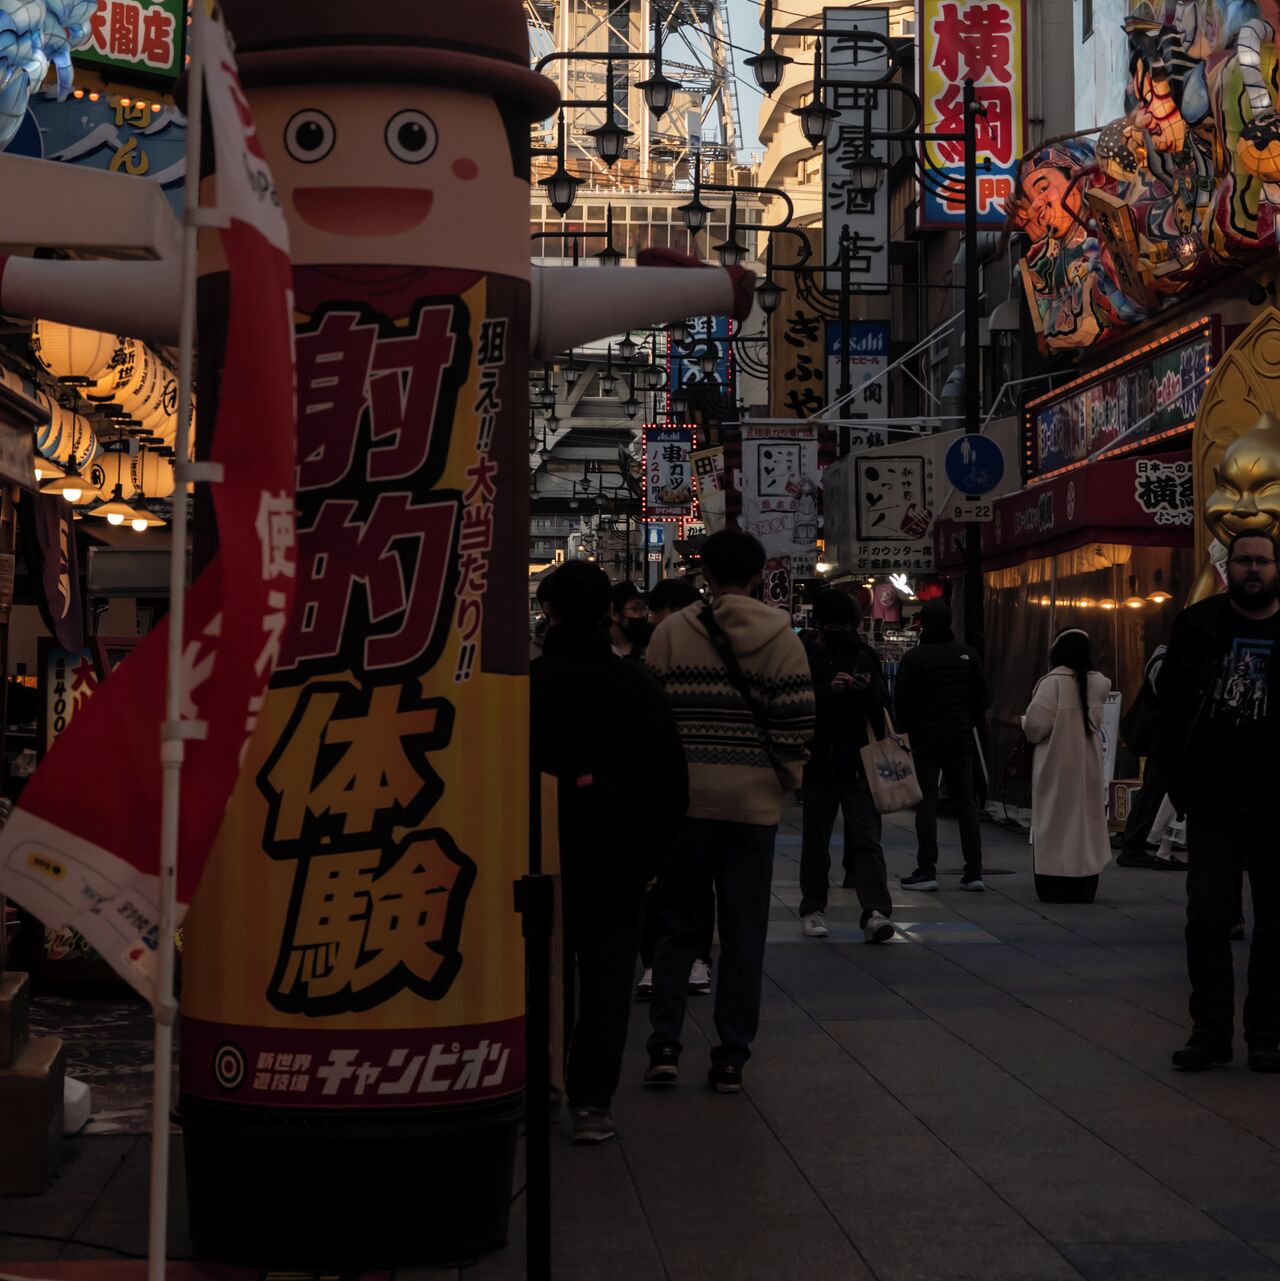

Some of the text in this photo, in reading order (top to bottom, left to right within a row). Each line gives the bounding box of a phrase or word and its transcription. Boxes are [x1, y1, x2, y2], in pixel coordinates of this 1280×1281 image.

[932, 2, 1012, 165] 横綱
[835, 356, 880, 365] アヒビール
[858, 546, 868, 556] 1F
[857, 559, 868, 569] 2F
[317, 1039, 511, 1097] チャンピオン
